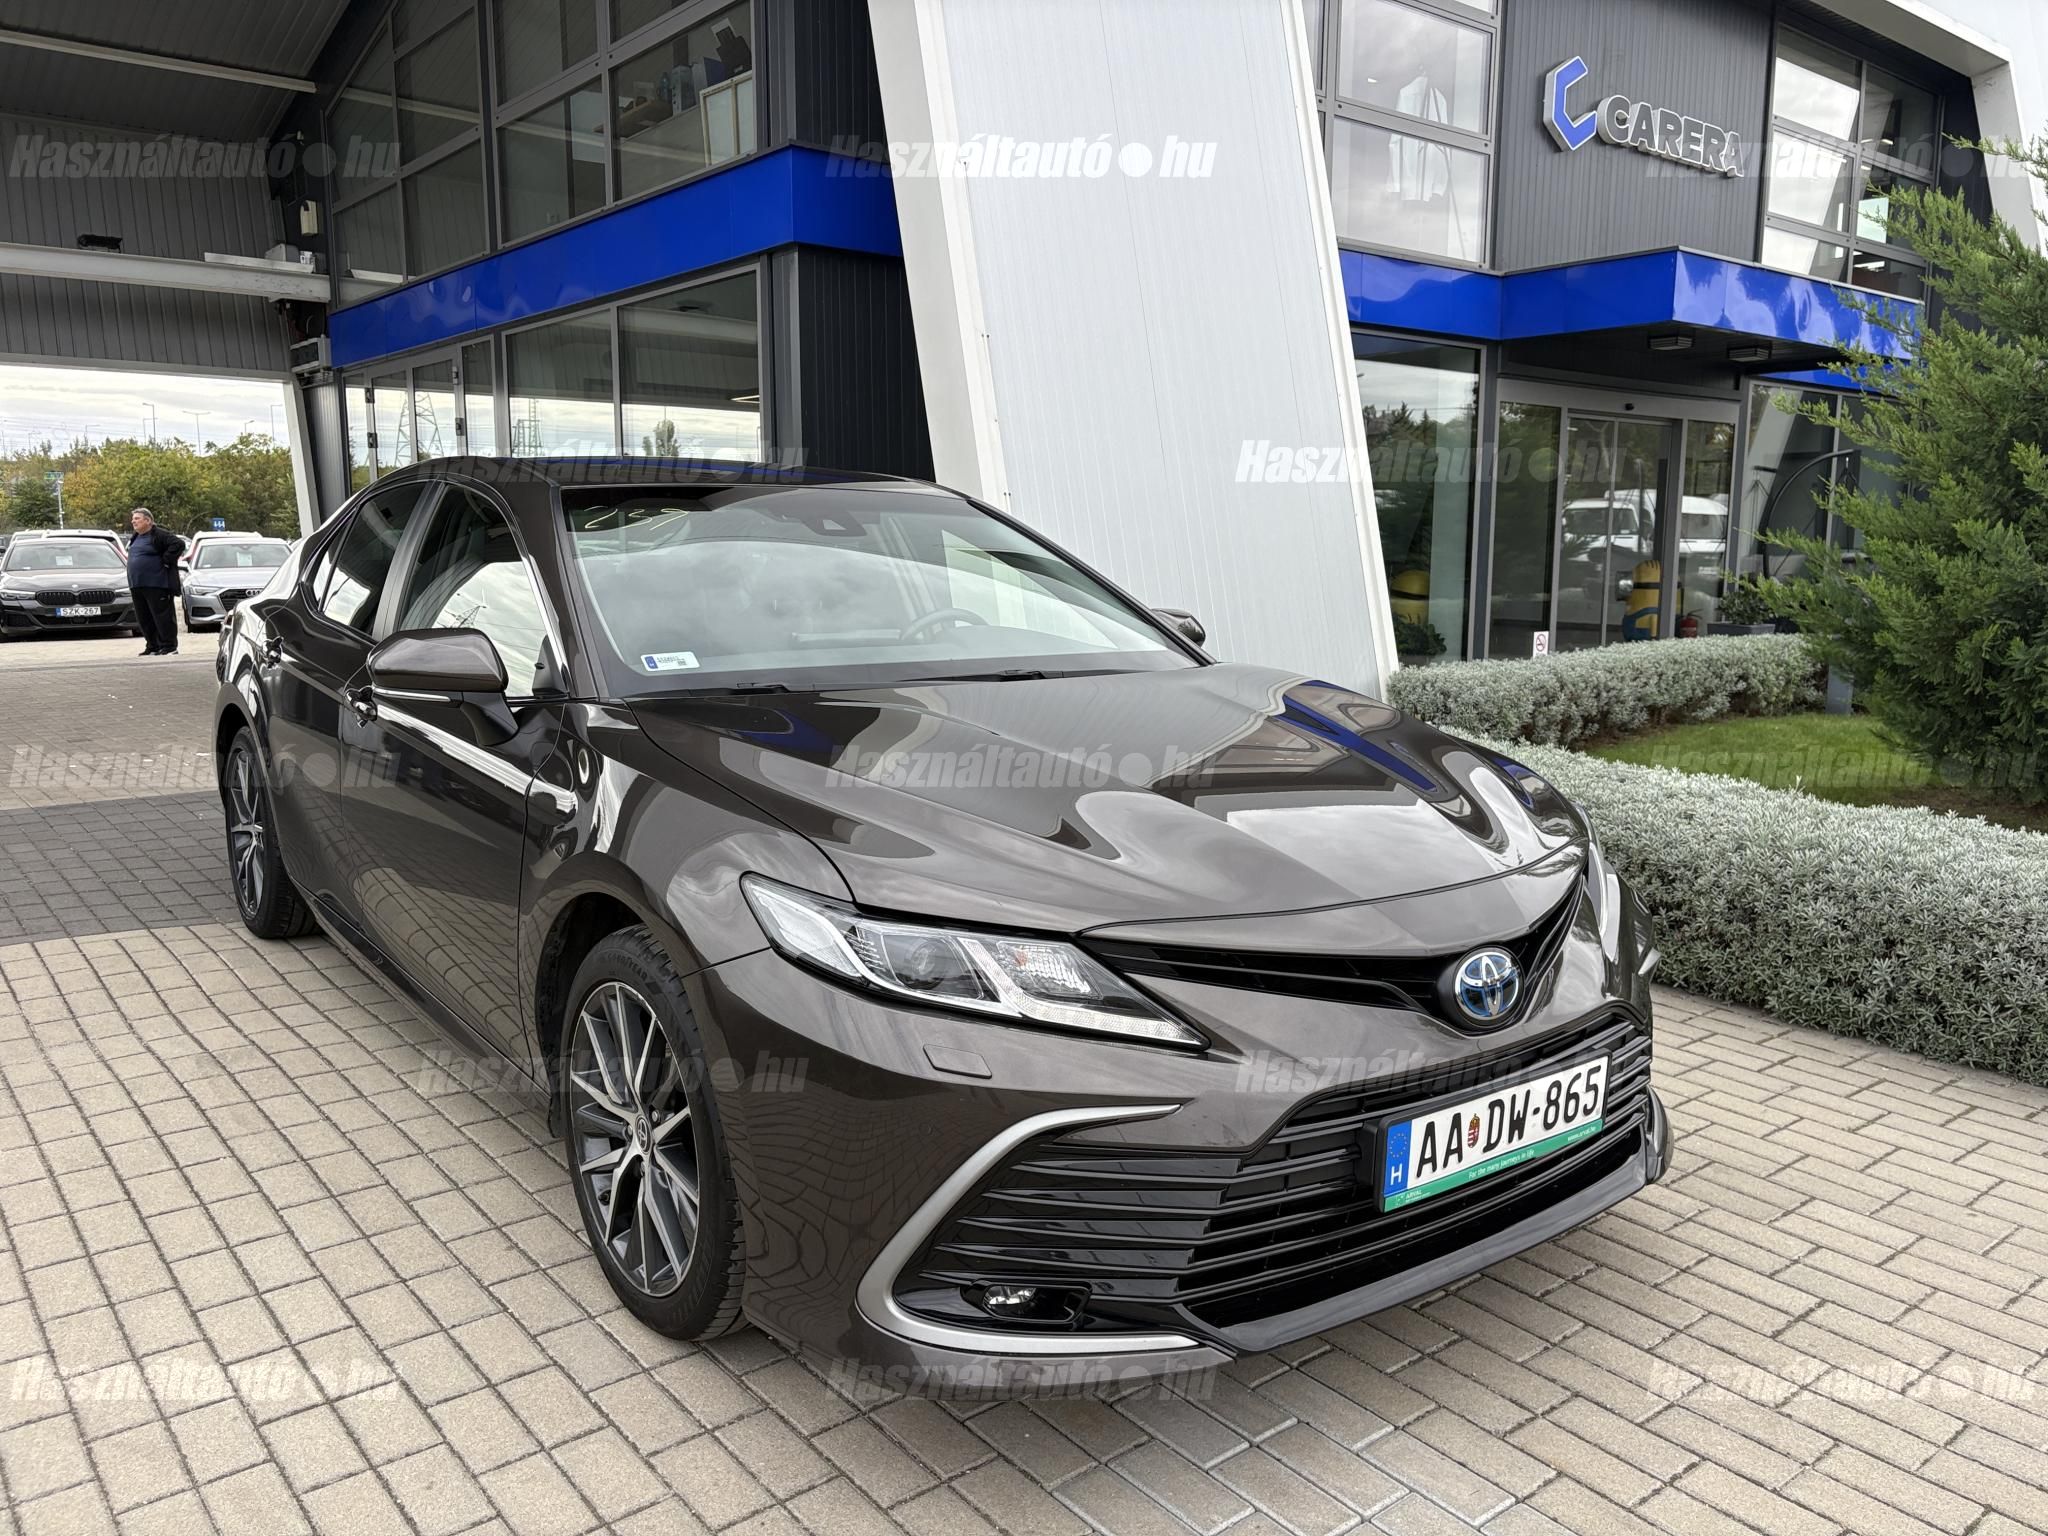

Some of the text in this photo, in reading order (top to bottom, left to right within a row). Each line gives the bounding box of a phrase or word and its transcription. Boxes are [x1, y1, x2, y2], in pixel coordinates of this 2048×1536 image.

[1598, 94, 1745, 178] CARERA
[1416, 1064, 1602, 1178] AA DW-865
[1468, 1170, 1478, 1179] For
